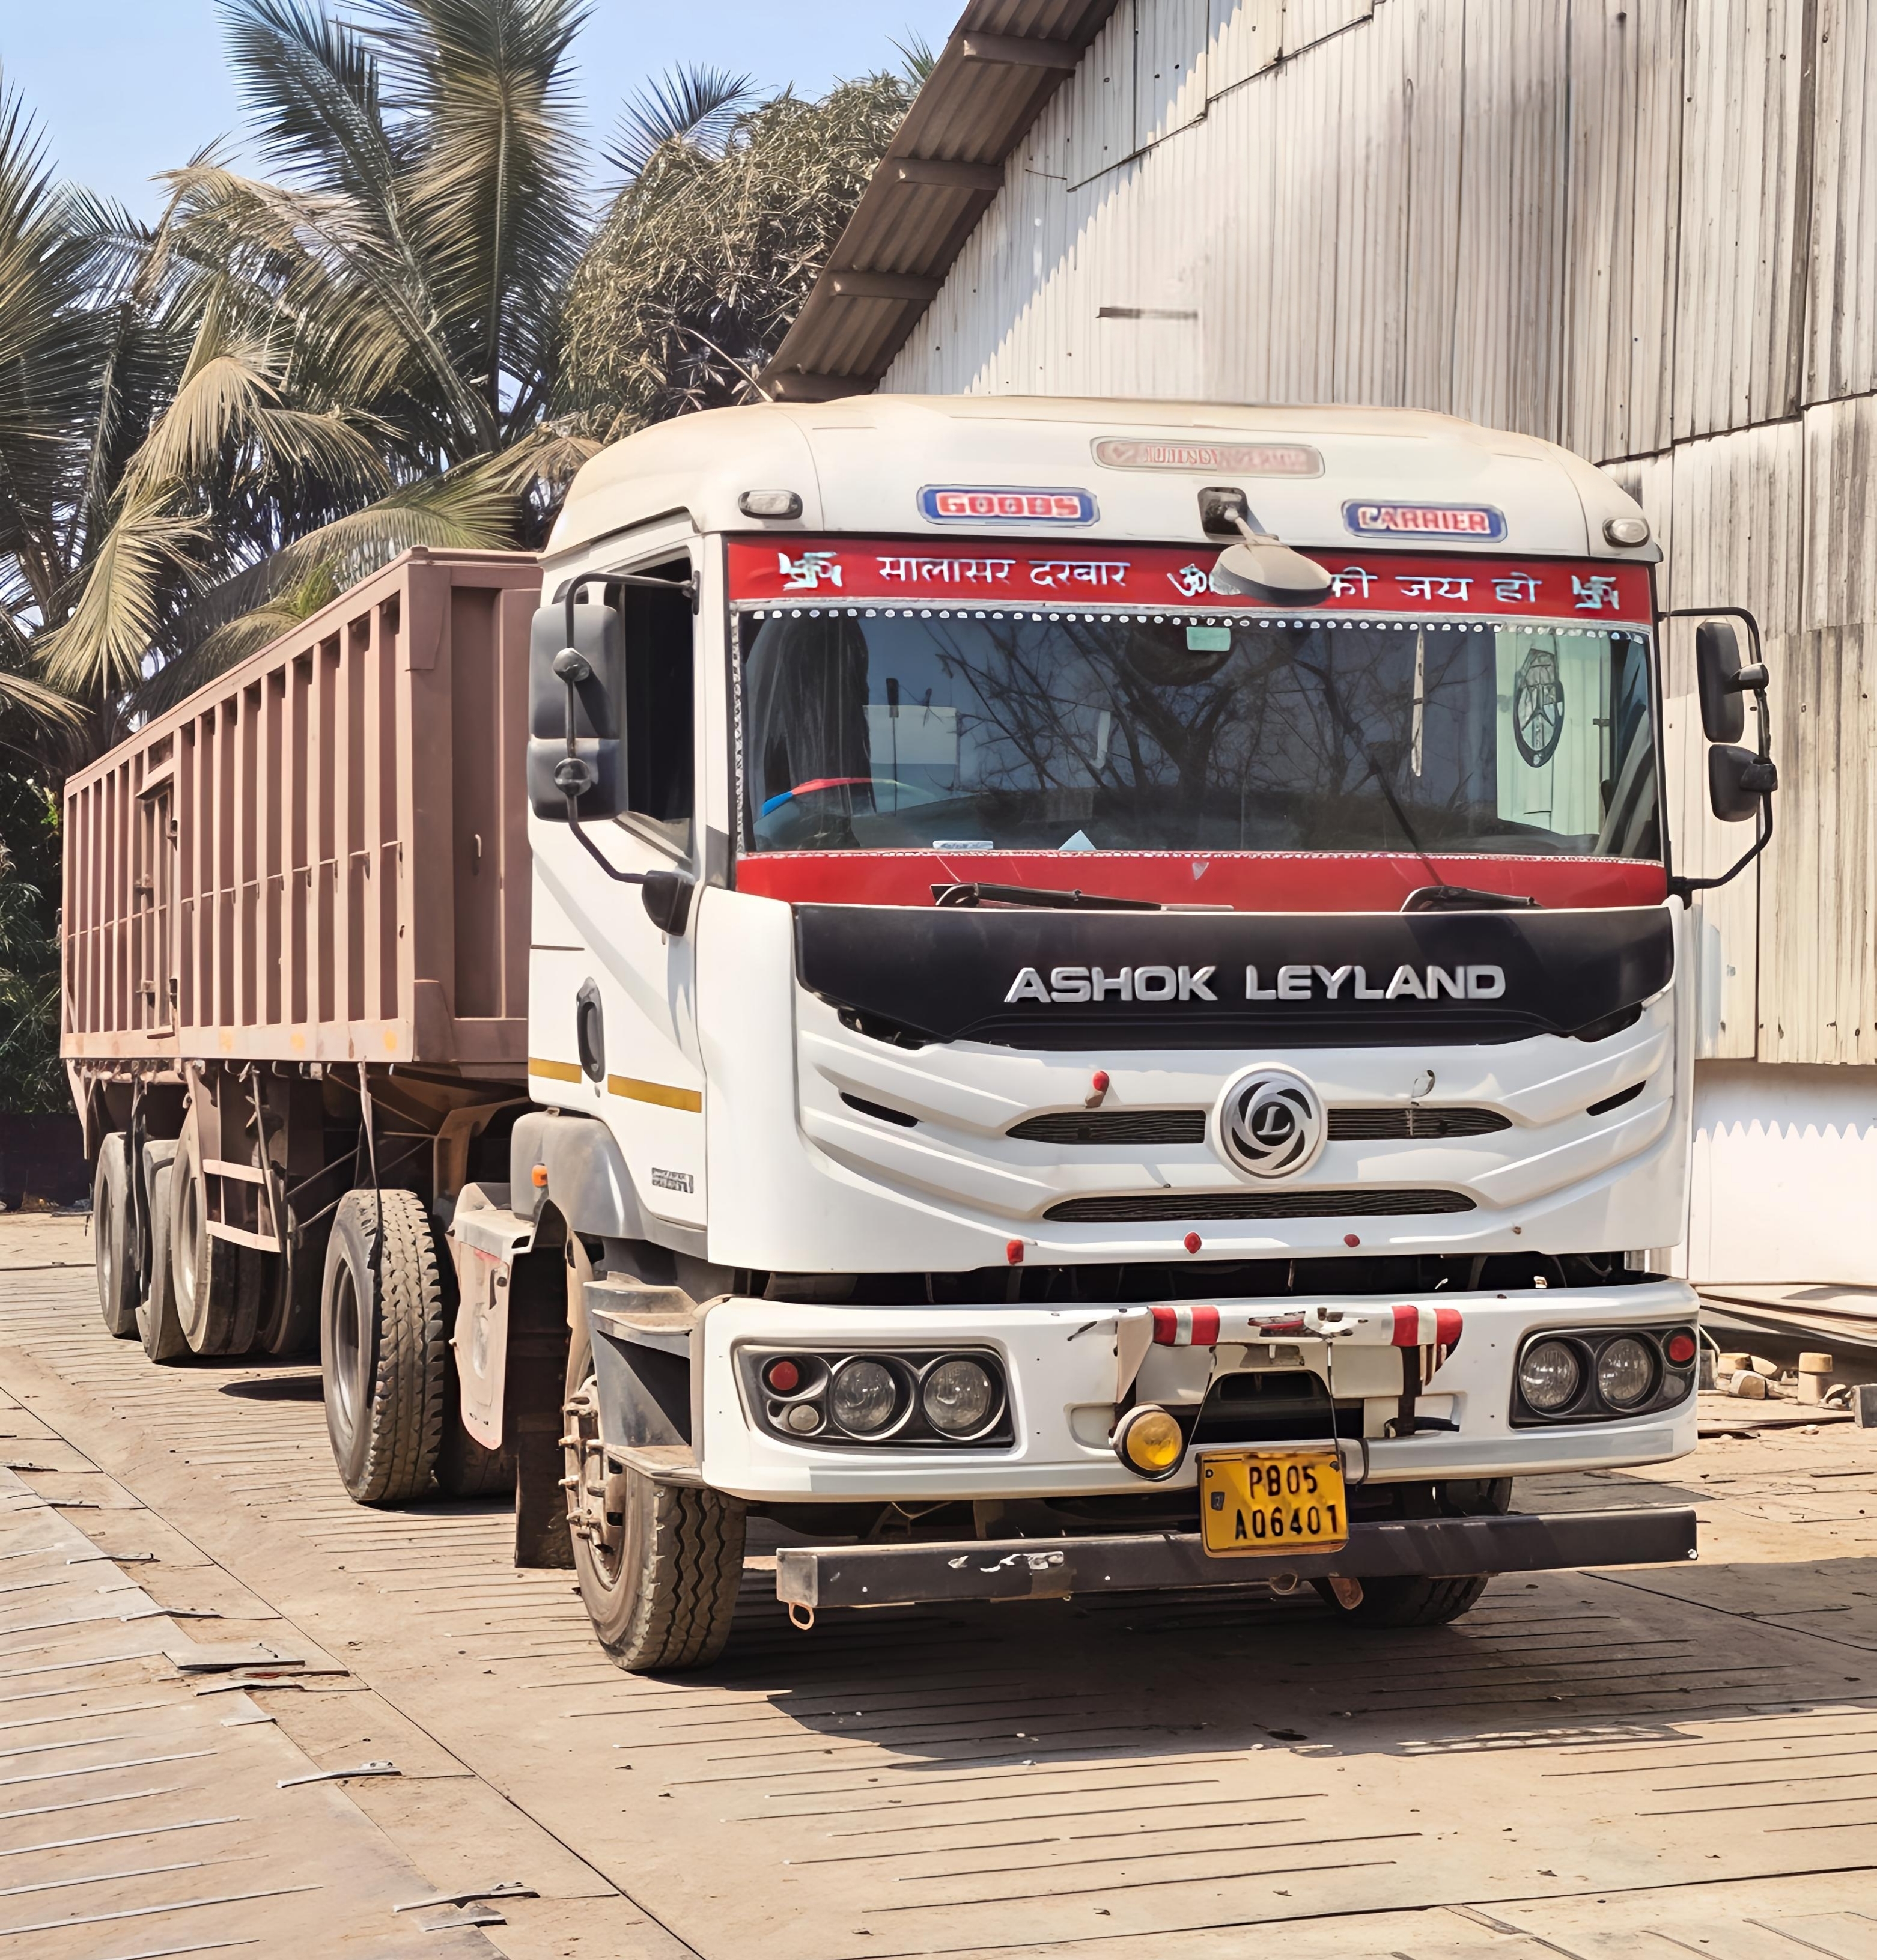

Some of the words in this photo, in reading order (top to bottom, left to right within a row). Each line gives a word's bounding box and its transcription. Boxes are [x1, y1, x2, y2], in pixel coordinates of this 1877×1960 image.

[935, 492, 1081, 519] GOODS
[1358, 507, 1491, 534] CARRIER
[876, 557, 1016, 585] सालासर
[1395, 576, 1474, 601] जय
[1491, 571, 1542, 603] हो
[1004, 965, 1218, 1003] ASHOK
[1245, 964, 1507, 1000] LEYLAND
[1249, 1465, 1318, 1499] PB05
